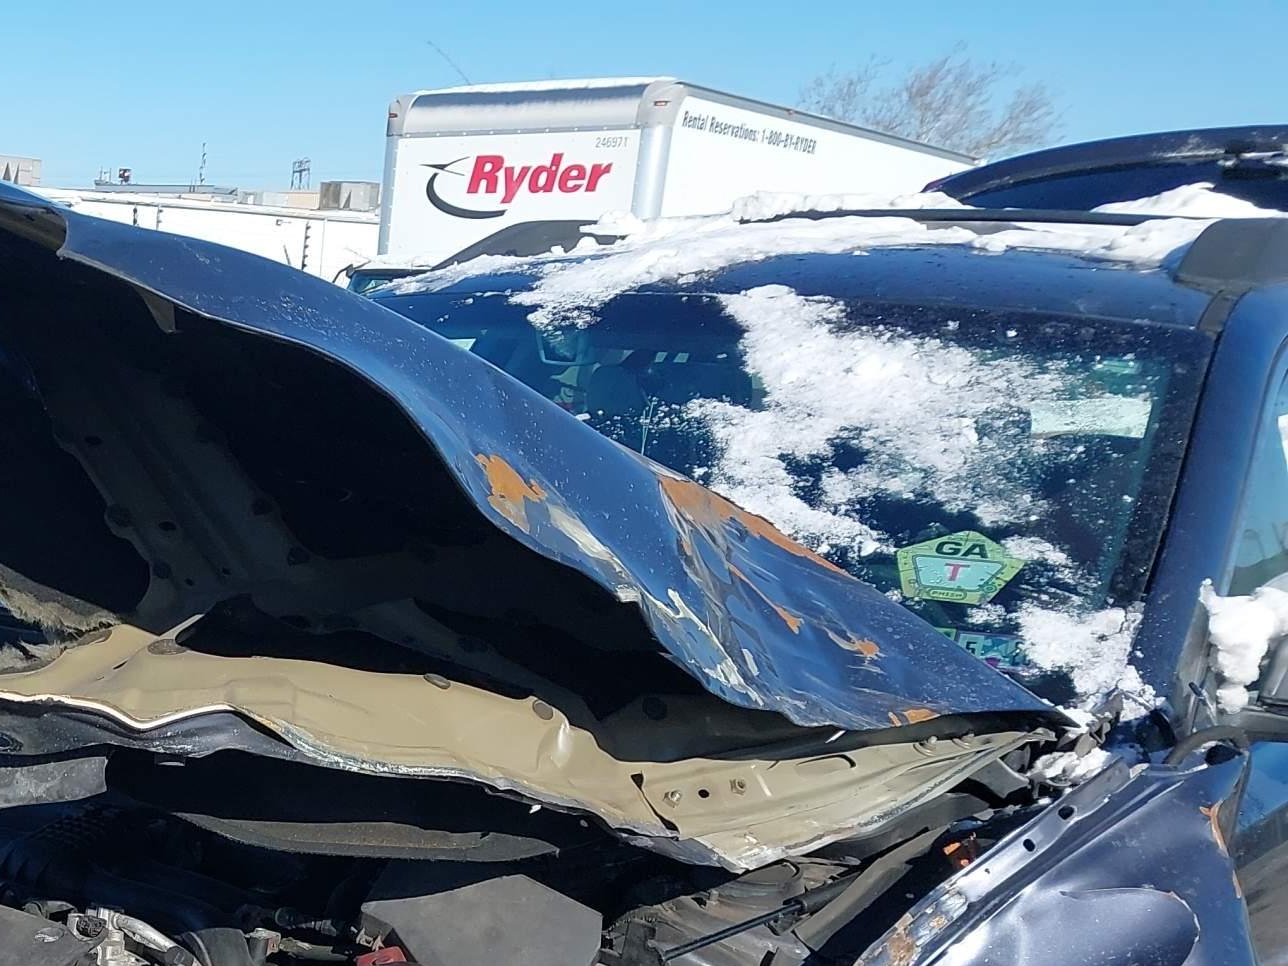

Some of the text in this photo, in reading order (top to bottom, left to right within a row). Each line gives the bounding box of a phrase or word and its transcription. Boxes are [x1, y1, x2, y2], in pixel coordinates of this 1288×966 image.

[595, 136, 629, 149] 246971
[681, 110, 817, 154] Rental Reservations: 1-800-BY-RYDER
[466, 152, 613, 204] Ryder
[935, 541, 989, 559] GA
